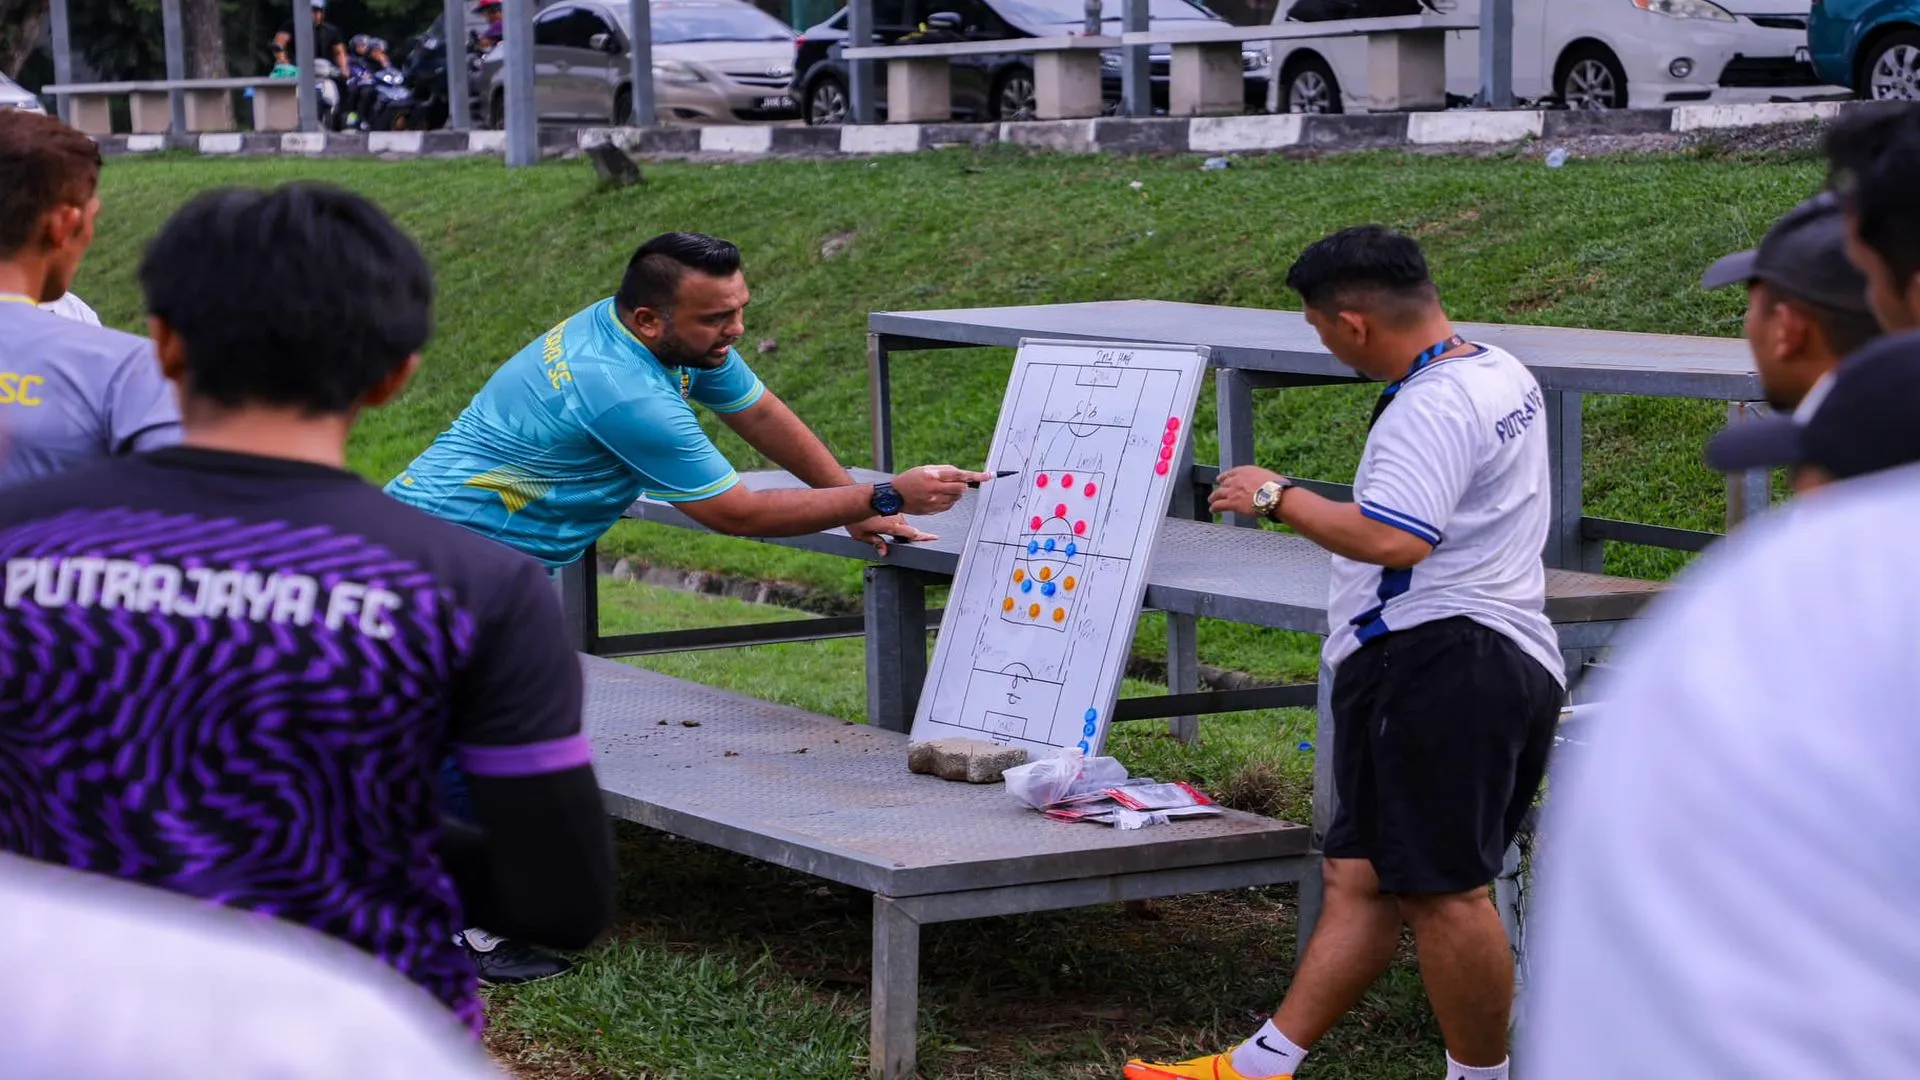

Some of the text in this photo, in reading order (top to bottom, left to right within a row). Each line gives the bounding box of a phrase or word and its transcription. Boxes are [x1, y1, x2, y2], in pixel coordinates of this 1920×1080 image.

[0, 371, 45, 407] SC
[547, 360, 573, 391] SC
[5, 557, 402, 640] PUTRAJAYA FC
